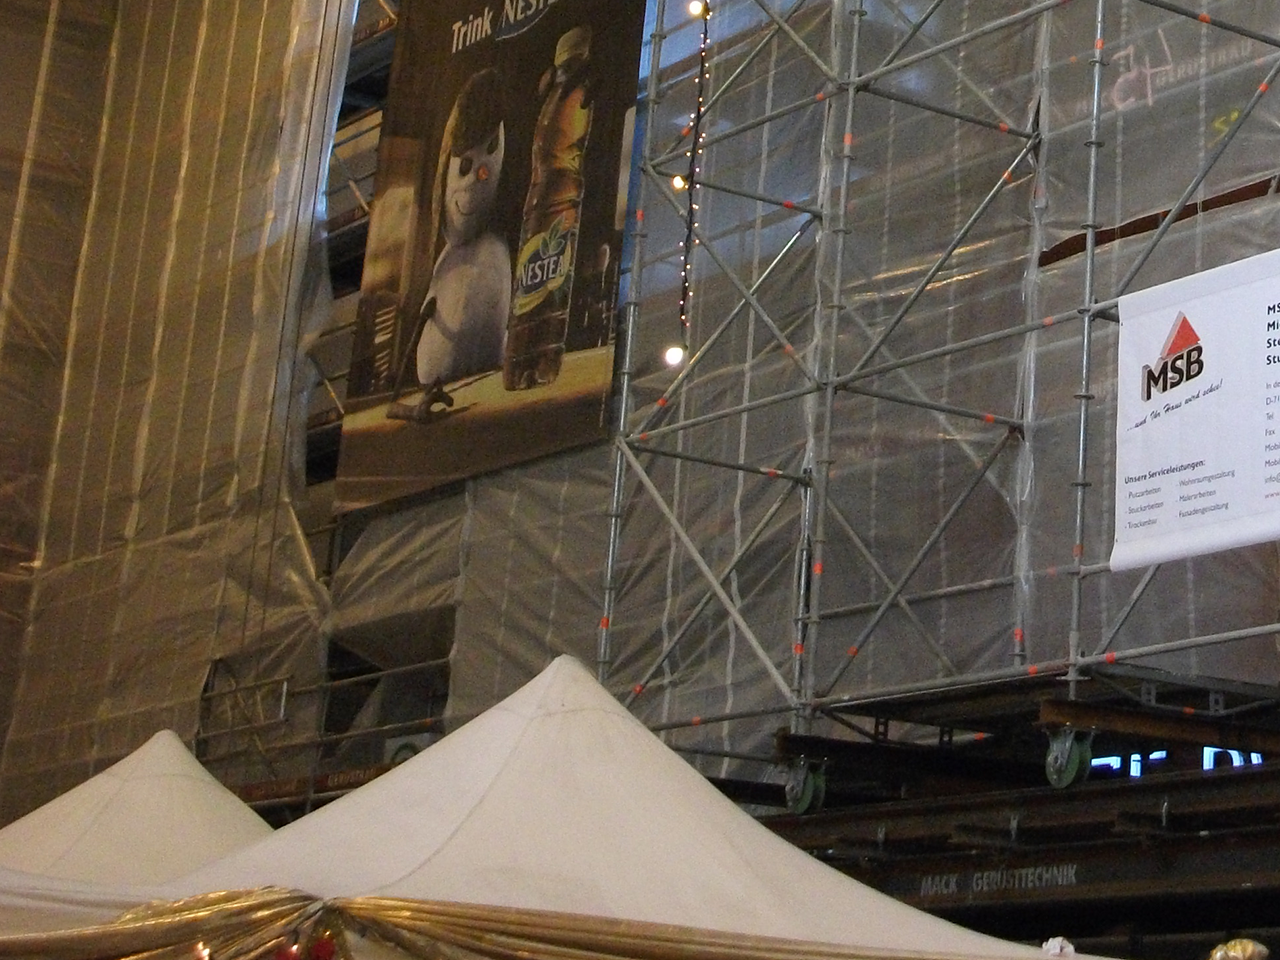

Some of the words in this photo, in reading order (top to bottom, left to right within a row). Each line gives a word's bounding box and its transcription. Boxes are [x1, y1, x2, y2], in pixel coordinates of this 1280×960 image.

[451, 7, 493, 54] Trink
[1141, 344, 1204, 402] MSB
[1124, 474, 1147, 485] Unsere
[921, 874, 957, 896] MACK
